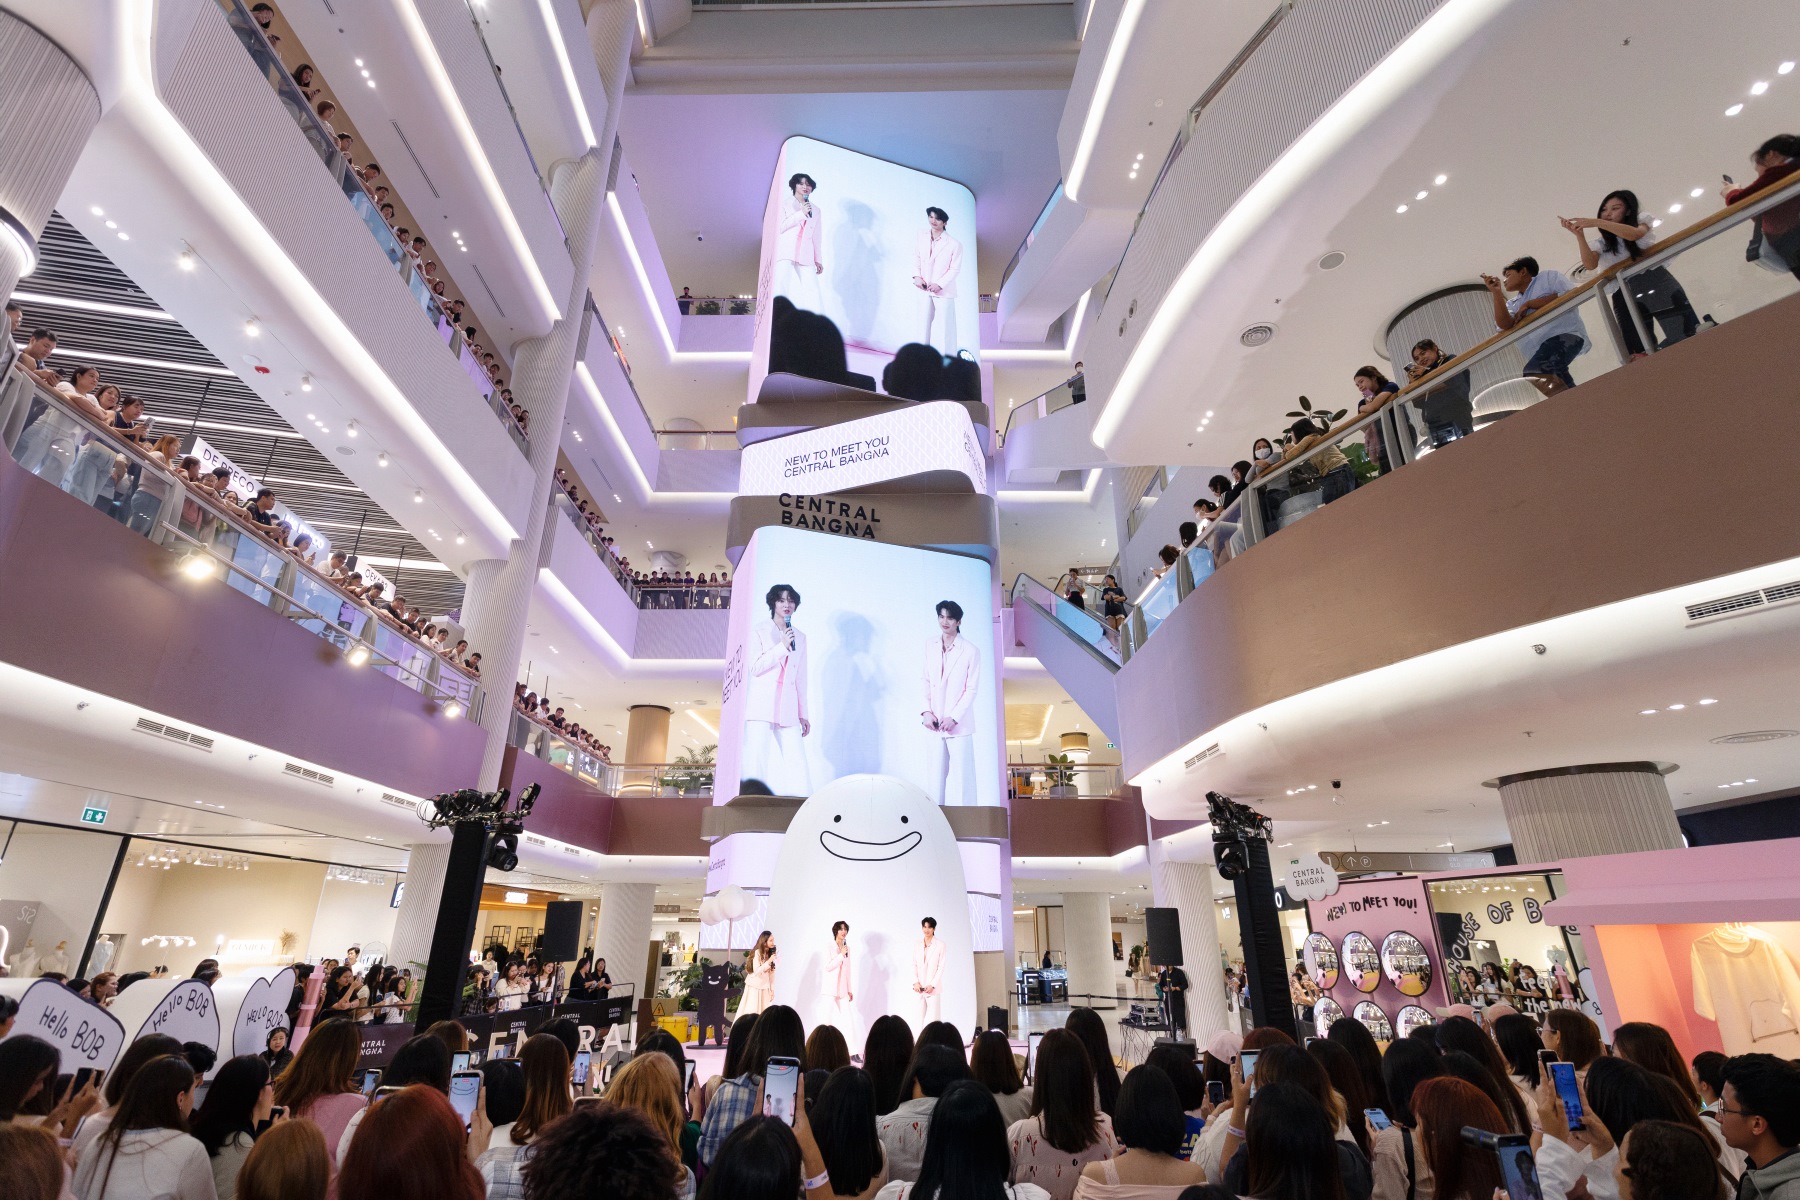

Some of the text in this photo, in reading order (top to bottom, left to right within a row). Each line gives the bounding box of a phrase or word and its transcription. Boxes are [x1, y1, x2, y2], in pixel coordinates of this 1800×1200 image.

[202, 448, 219, 468] DE
[783, 447, 890, 478] CENTRAL BANGNA
[784, 435, 890, 468] NEW TO MEET YOU
[778, 492, 881, 523] CENTRAL
[780, 509, 876, 540] BANGNA
[1292, 867, 1325, 878] CENTRAL
[1295, 876, 1325, 887] BANGNA
[1349, 900, 1362, 913] TO
[1361, 895, 1388, 912] MEET
[1392, 896, 1418, 914] YOU!
[1448, 911, 1481, 974] HOUSE
[1487, 900, 1514, 925] OF
[152, 988, 209, 1032] Hello BOB
[246, 1005, 268, 1027] HELLO
[1524, 997, 1550, 1014] the
[38, 1005, 105, 1061] Hello BOB
